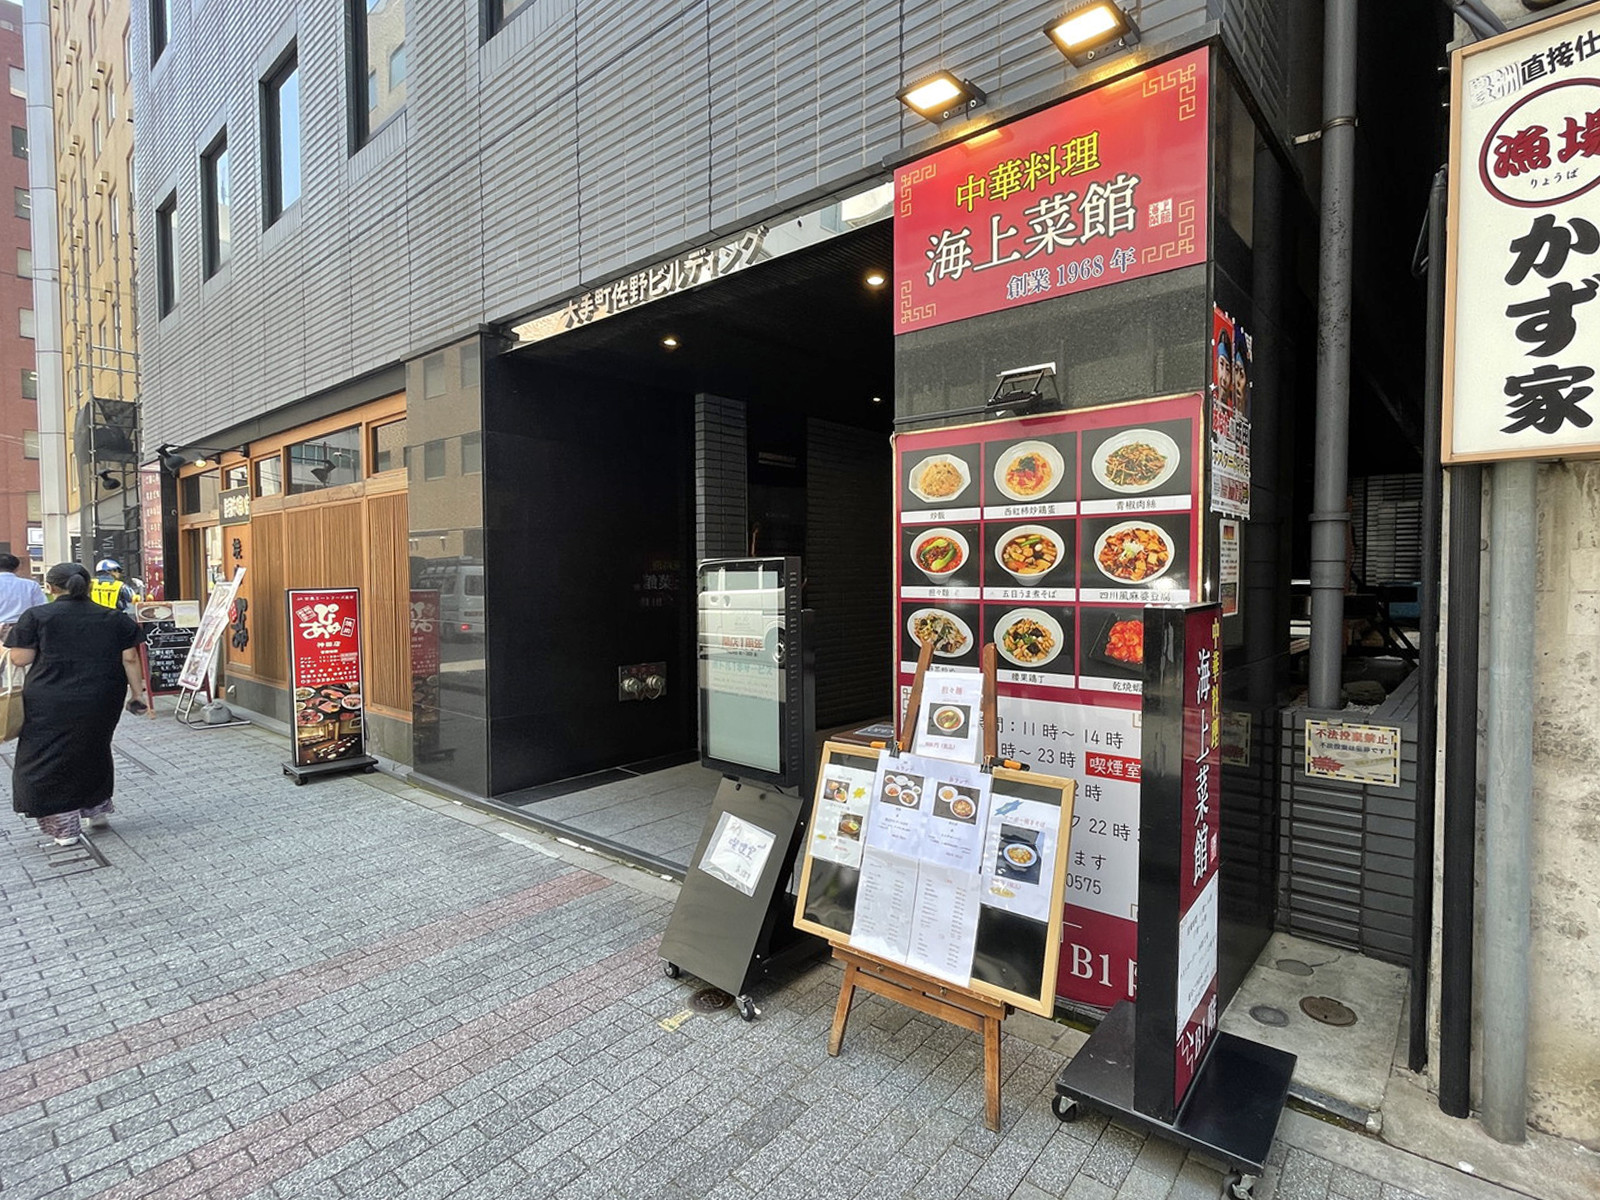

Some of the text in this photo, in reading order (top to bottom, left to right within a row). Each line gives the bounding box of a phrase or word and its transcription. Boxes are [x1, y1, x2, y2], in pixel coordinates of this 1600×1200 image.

[956, 131, 1101, 212] 中華料理
[1530, 168, 1579, 189] りょうば
[926, 174, 1140, 287] 海上菜館
[562, 225, 770, 329] 大手町佐野ビルディング
[1006, 247, 1136, 299] 創業 1968 年
[1500, 214, 1600, 434] かず家
[1211, 617, 1220, 750] 中華料理
[1089, 757, 1141, 779] 喫煙室
[1194, 648, 1211, 886] 海上菜館
[1065, 873, 1102, 895] 0575
[1074, 850, 1107, 871] ます
